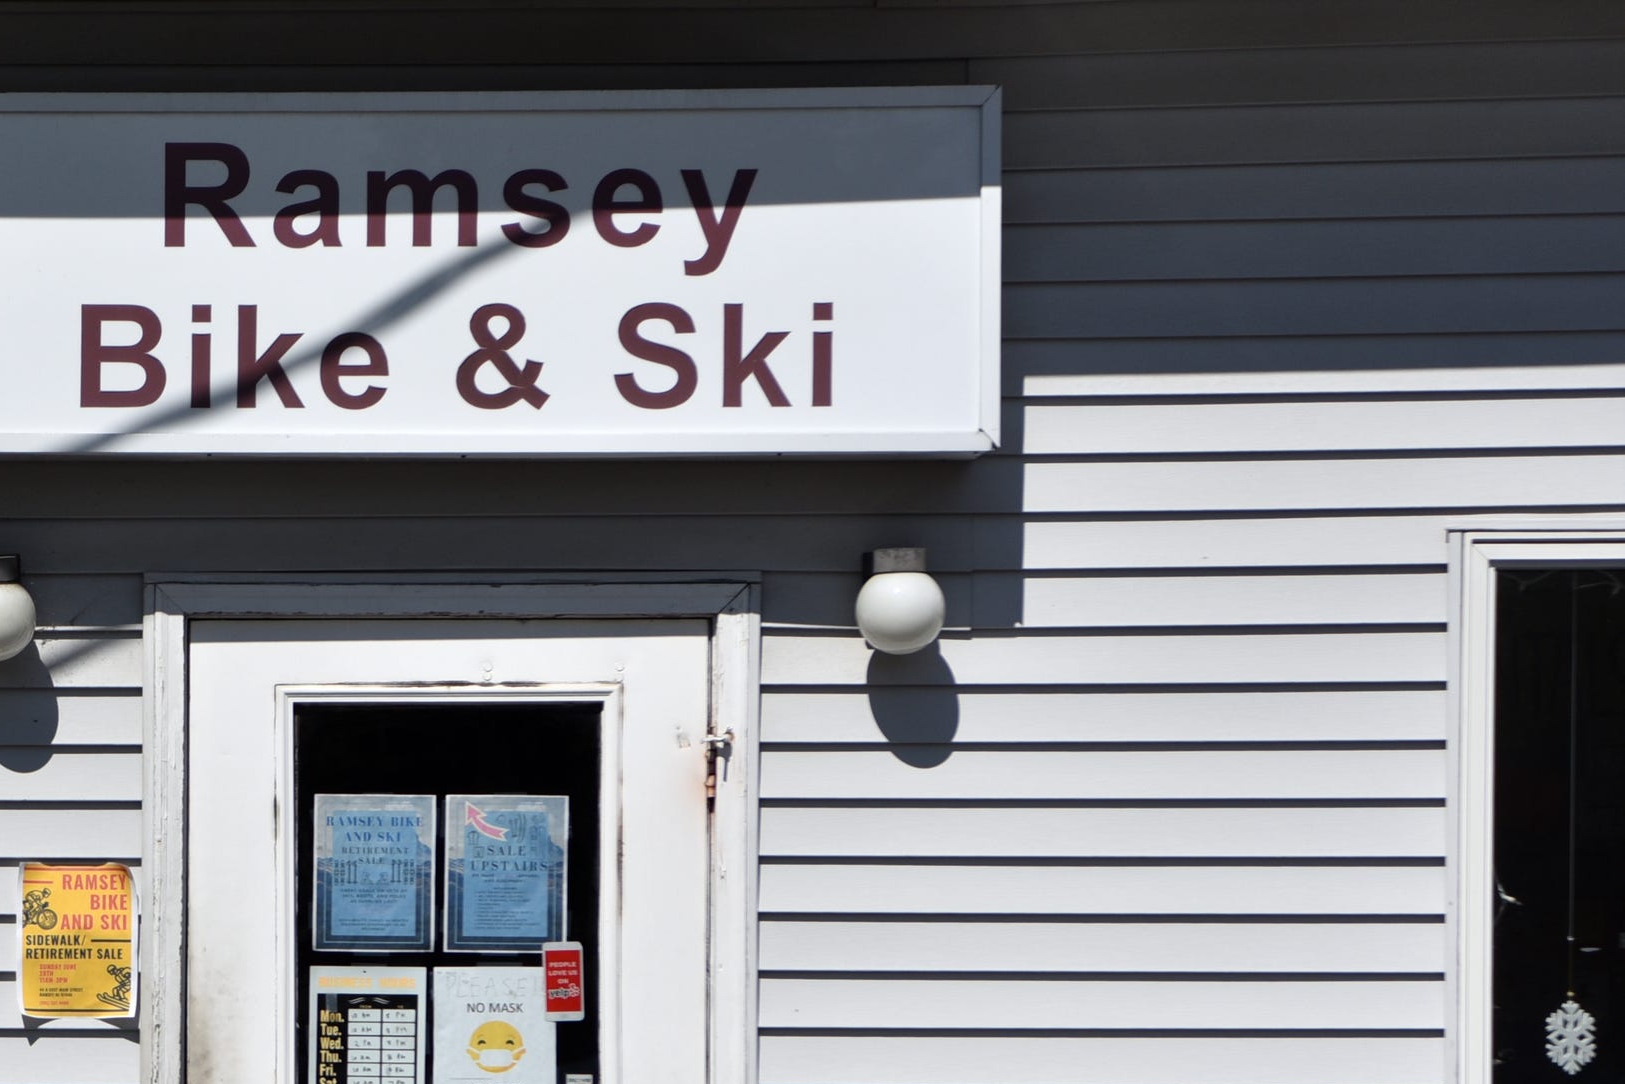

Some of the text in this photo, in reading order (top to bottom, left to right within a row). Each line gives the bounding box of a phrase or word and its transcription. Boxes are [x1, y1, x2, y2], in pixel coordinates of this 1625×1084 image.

[162, 141, 758, 277] Ramsey
[79, 301, 834, 411] Bike & Ski
[326, 816, 424, 827] RAMSEY BIKE
[345, 831, 401, 842] AND SKI
[342, 847, 409, 855] RETIREMENT
[486, 845, 527, 856] SALE
[359, 857, 384, 865] SALE
[470, 860, 549, 872] UPSTAIRS
[62, 874, 126, 890] RAMSEY
[91, 894, 127, 910] BIKE
[61, 914, 127, 930] AND SKI
[26, 935, 87, 946] SIDEWALK/
[26, 948, 123, 959] RETIREMENT SALE
[549, 987, 570, 999] yelp
[466, 1003, 523, 1013] NO MASK
[320, 1010, 344, 1022] Mon.
[320, 1024, 342, 1036] Tue.
[320, 1037, 344, 1049] Wed.
[320, 1050, 342, 1063] Thu.
[319, 1064, 336, 1076] Fri.
